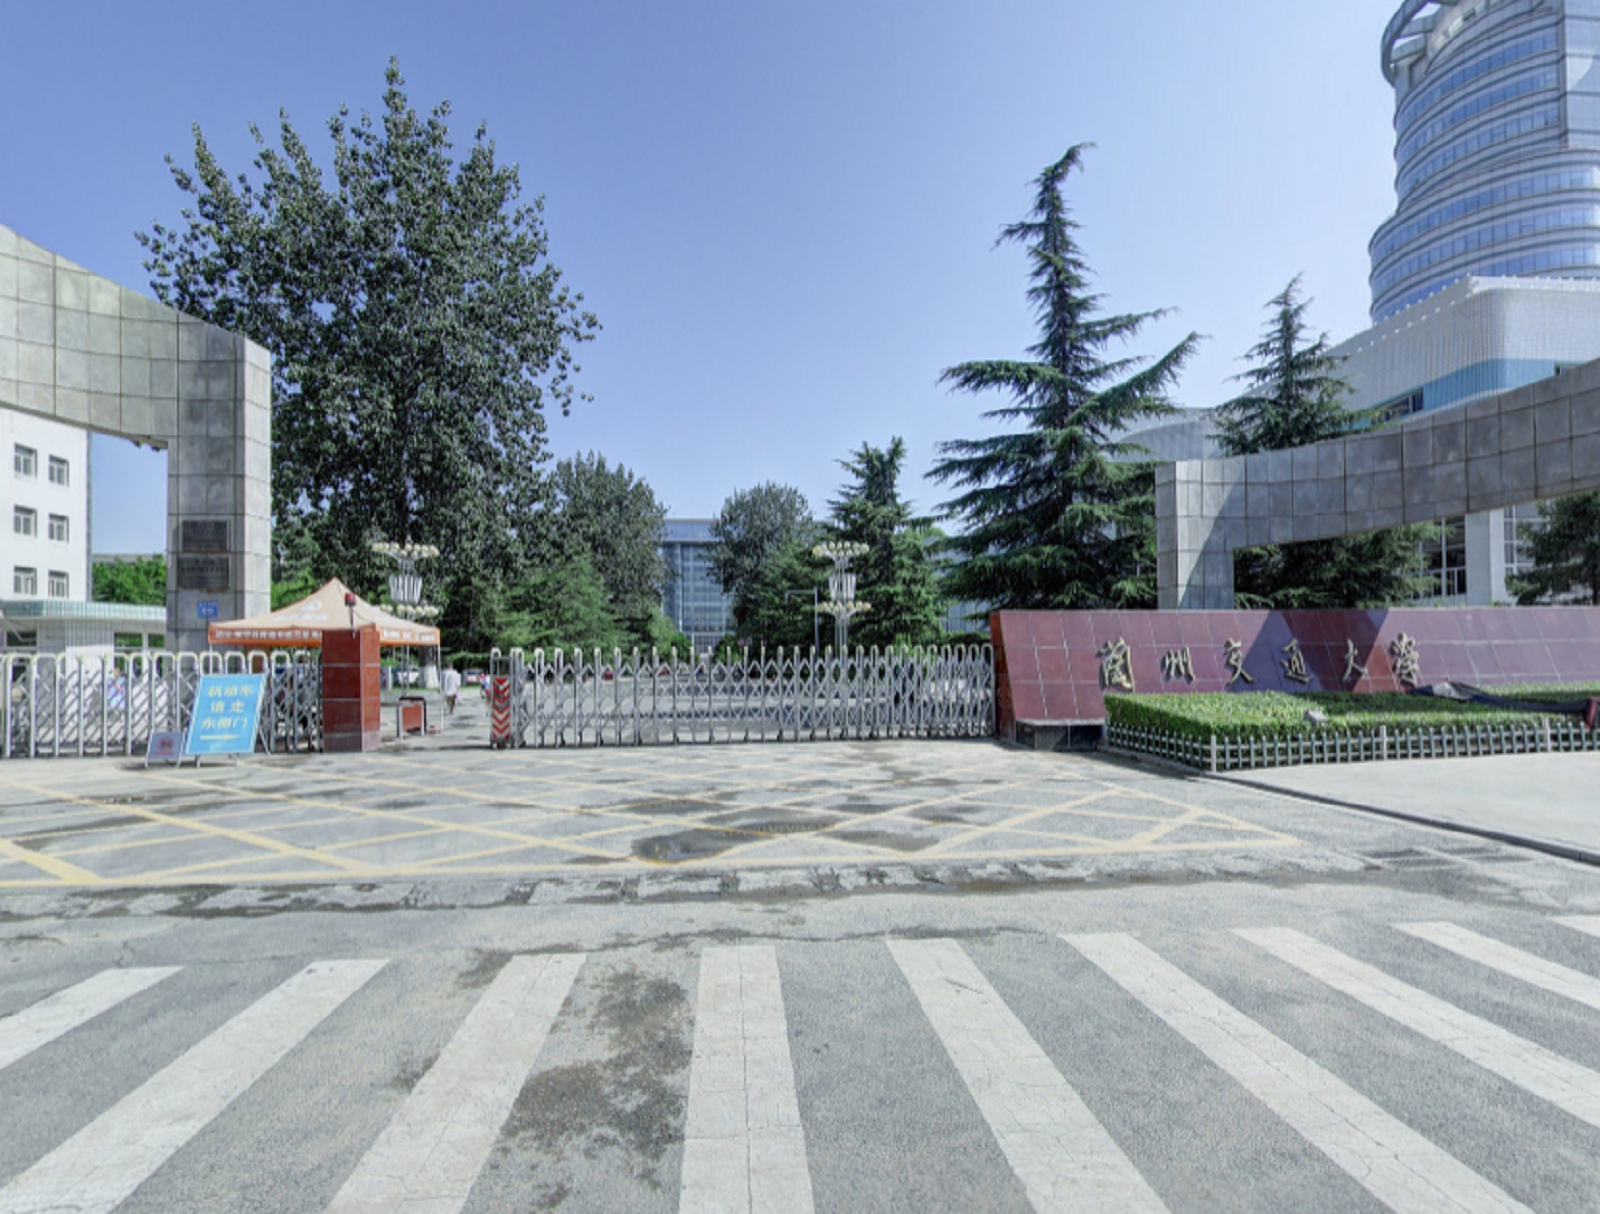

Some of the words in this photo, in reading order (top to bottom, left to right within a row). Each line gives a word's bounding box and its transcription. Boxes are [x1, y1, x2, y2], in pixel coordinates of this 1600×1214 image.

[208, 684, 253, 698] 机动车
[210, 700, 245, 714] 请走
[201, 716, 248, 729] 东侧门
